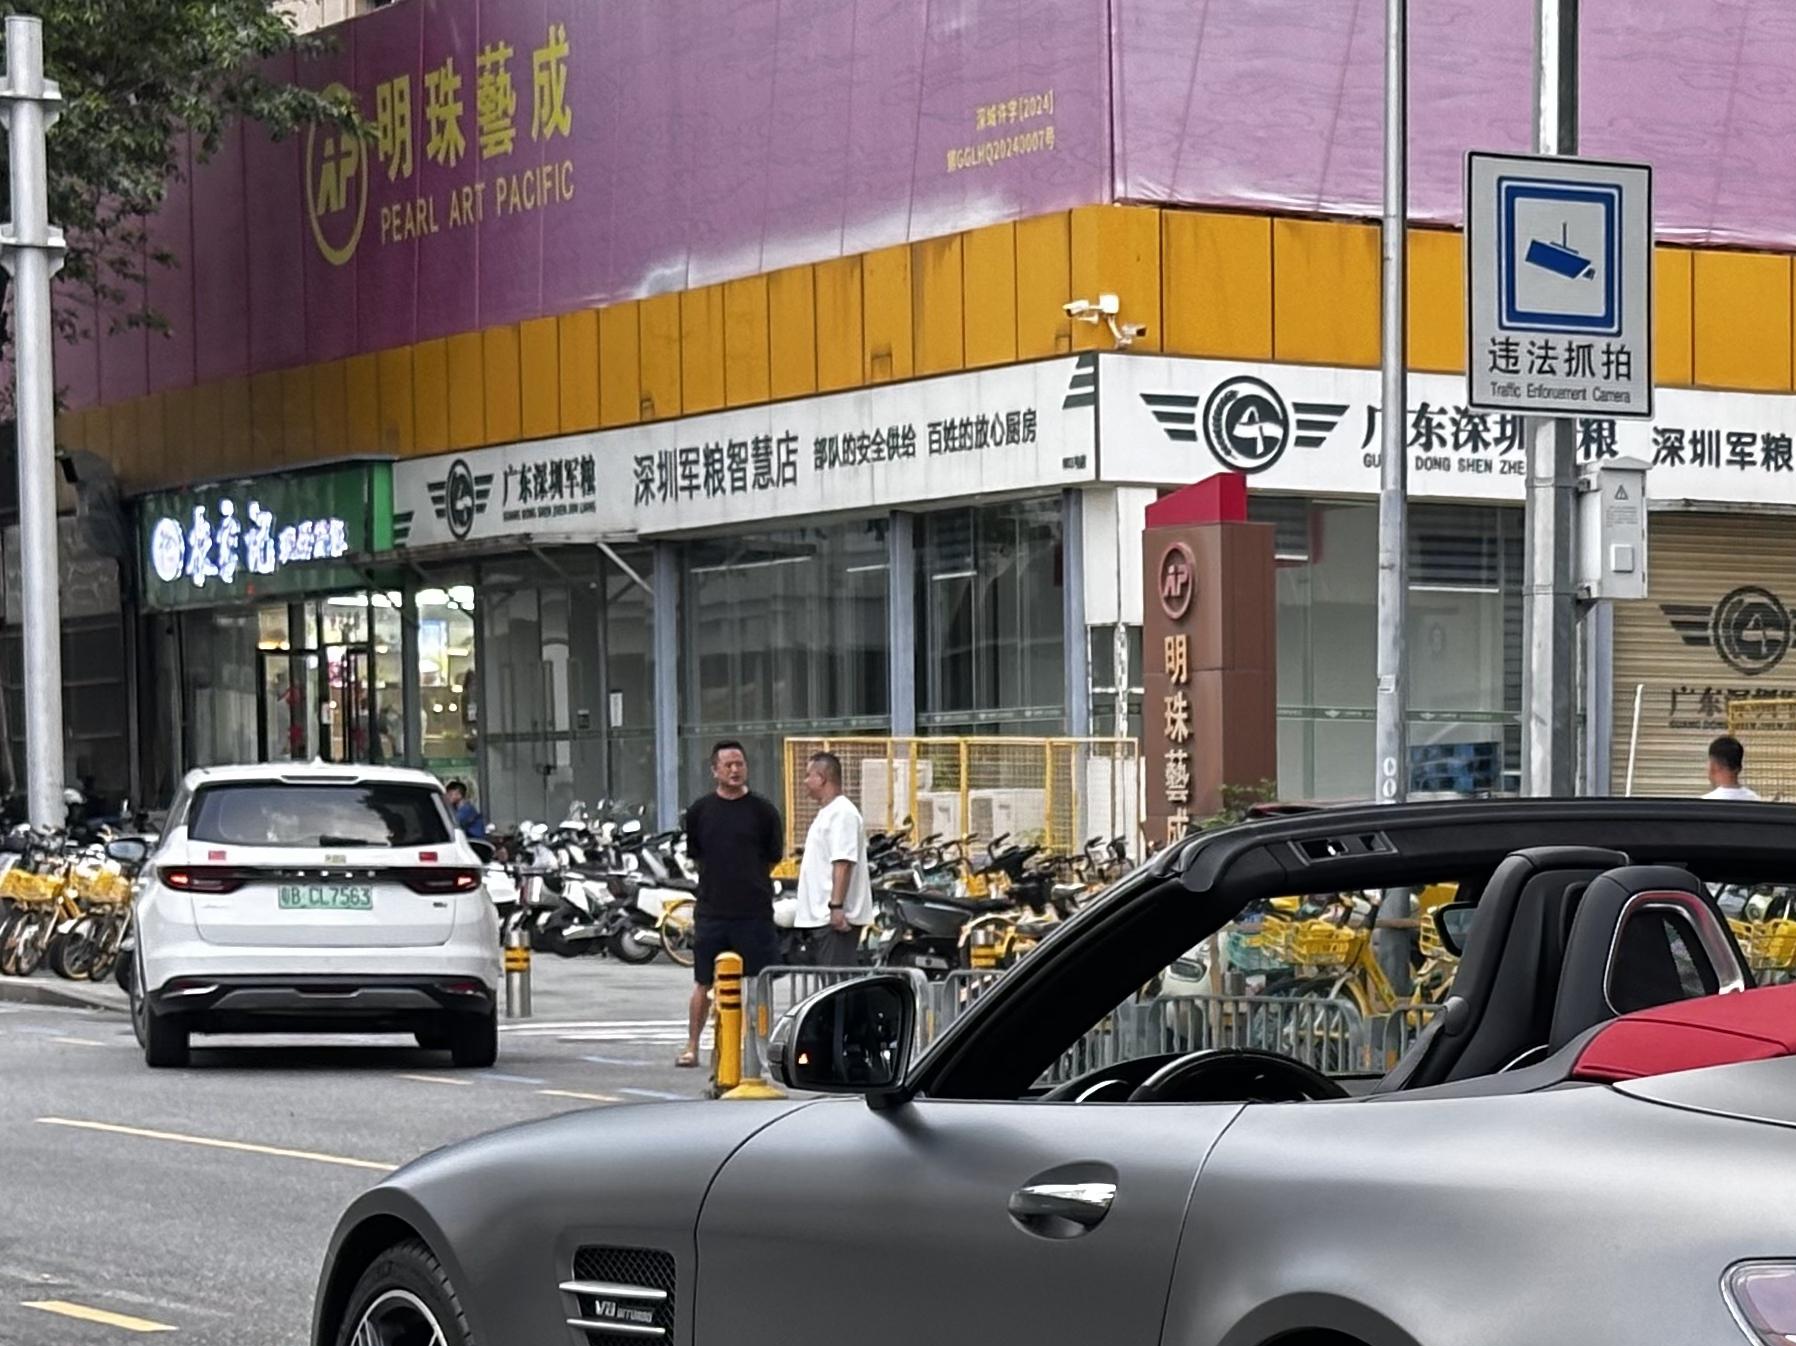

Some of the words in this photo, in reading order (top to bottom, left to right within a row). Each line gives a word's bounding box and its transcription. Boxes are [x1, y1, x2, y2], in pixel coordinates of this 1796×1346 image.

[376, 23, 573, 183] 明珠藝成
[381, 196, 438, 245] PEARL
[450, 181, 485, 229] ART
[496, 160, 574, 217] PACIFIC
[1489, 337, 1632, 381] 违法抓拍
[1490, 381, 1521, 398] Traffic
[1592, 386, 1631, 403] Camera
[633, 430, 799, 507] 深圳军粮智慧店
[814, 423, 916, 471] 部队的安全供给
[927, 408, 1037, 456] 百姓的放心厨房
[1361, 402, 1618, 459] 广东深圳粮
[1415, 455, 1450, 471] DONG
[1458, 458, 1492, 473] SHEN
[1500, 459, 1525, 475] ZHE
[1164, 634, 1190, 842] 明珠藝成
